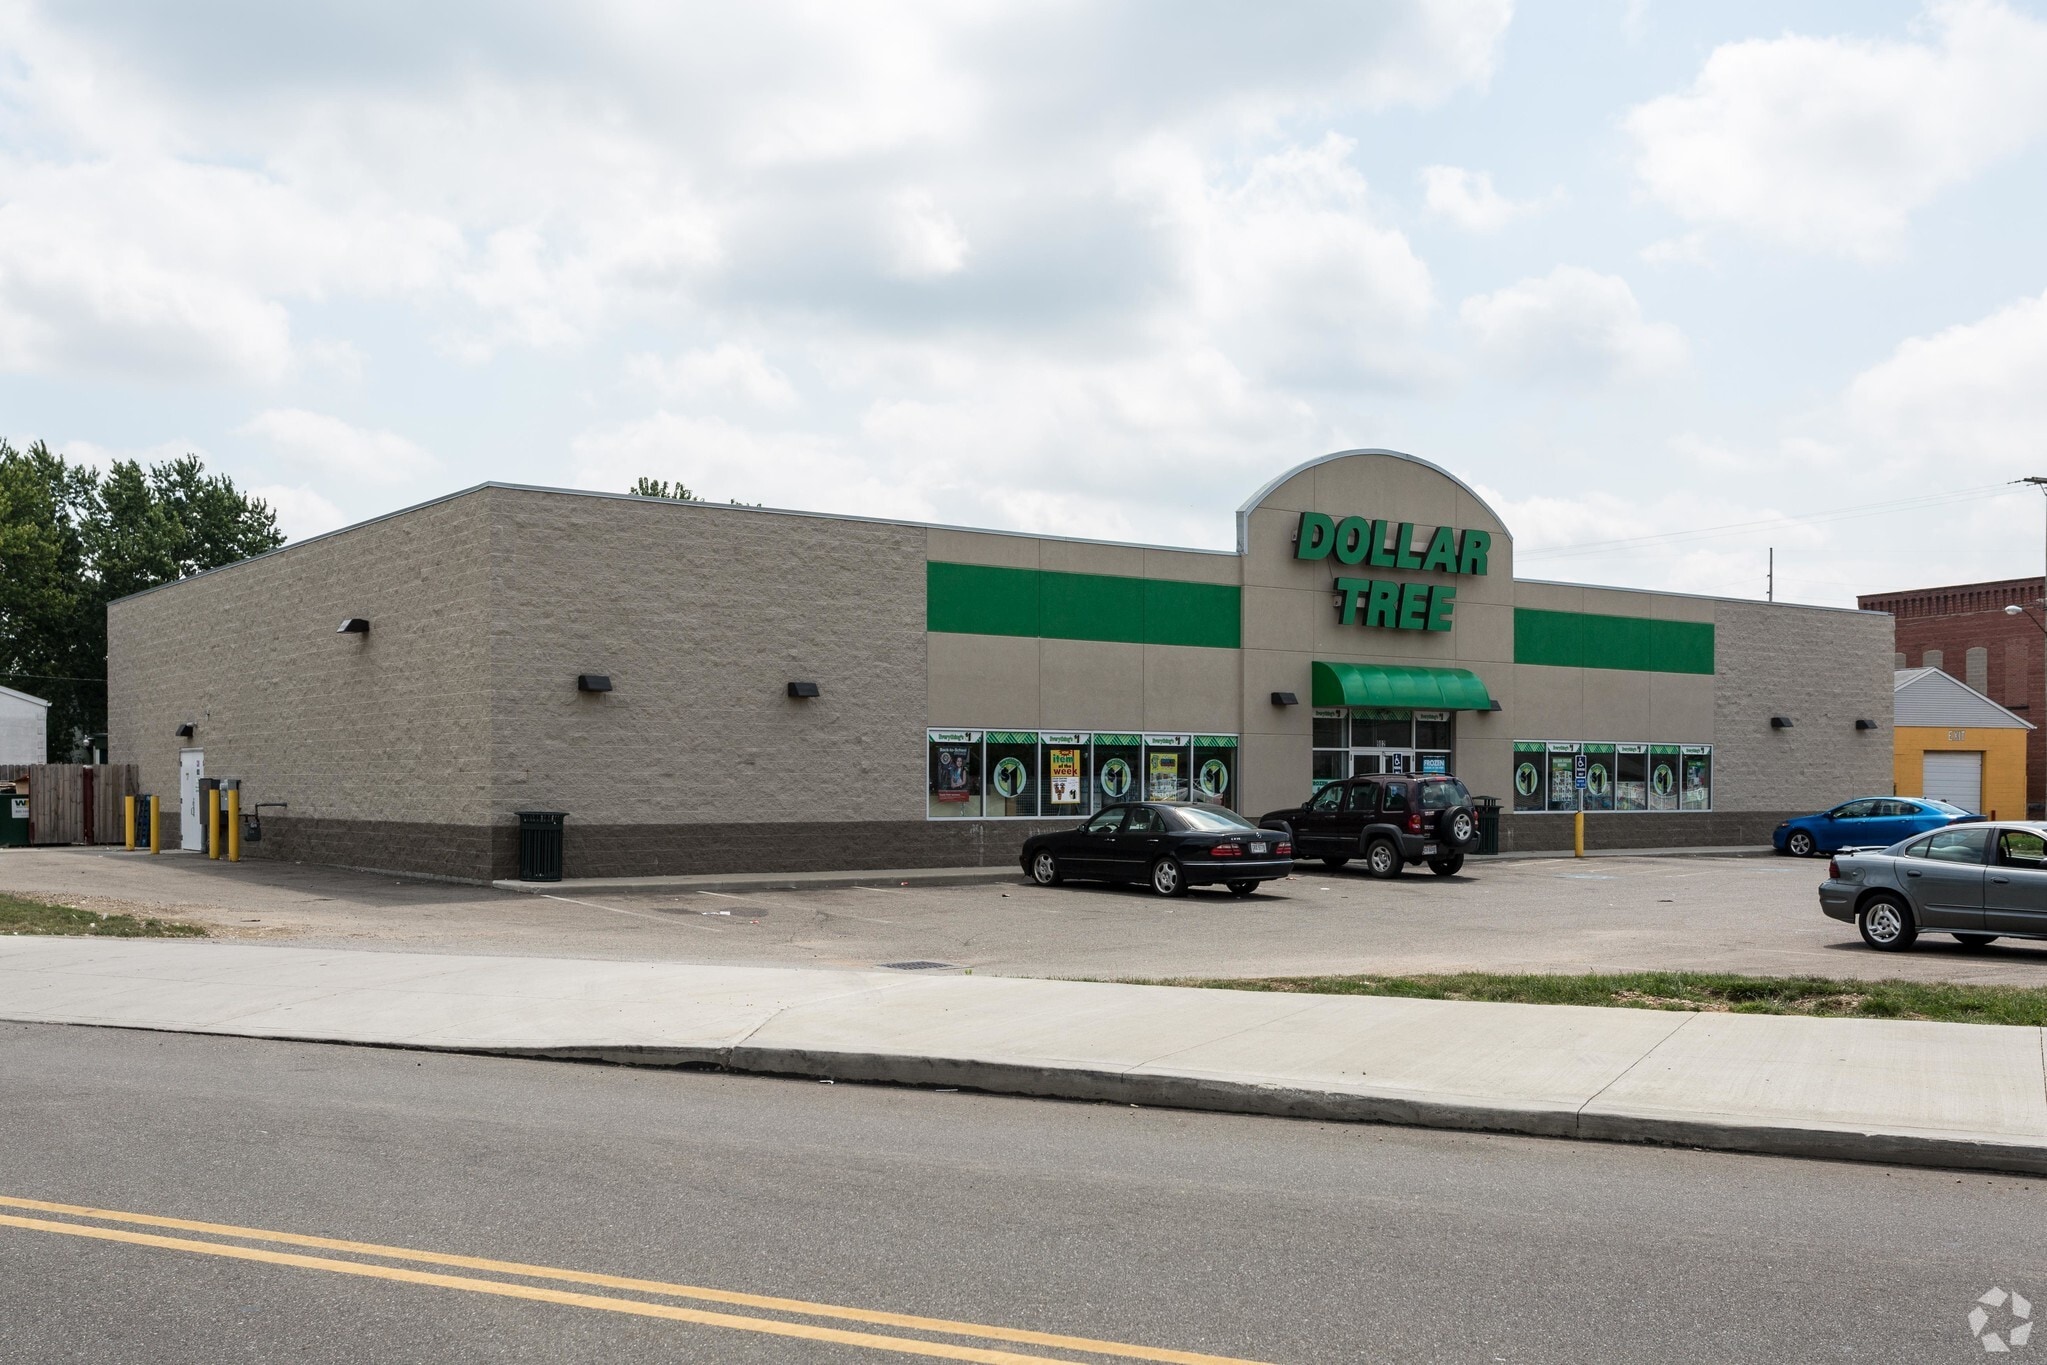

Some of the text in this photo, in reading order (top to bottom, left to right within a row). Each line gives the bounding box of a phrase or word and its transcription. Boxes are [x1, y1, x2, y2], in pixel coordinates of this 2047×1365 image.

[1294, 511, 1491, 576] DOLLAR
[1333, 577, 1456, 632] TREE
[1948, 730, 1965, 741] EXIT
[1053, 754, 1075, 764] item
[1424, 759, 1445, 767] FROZEN
